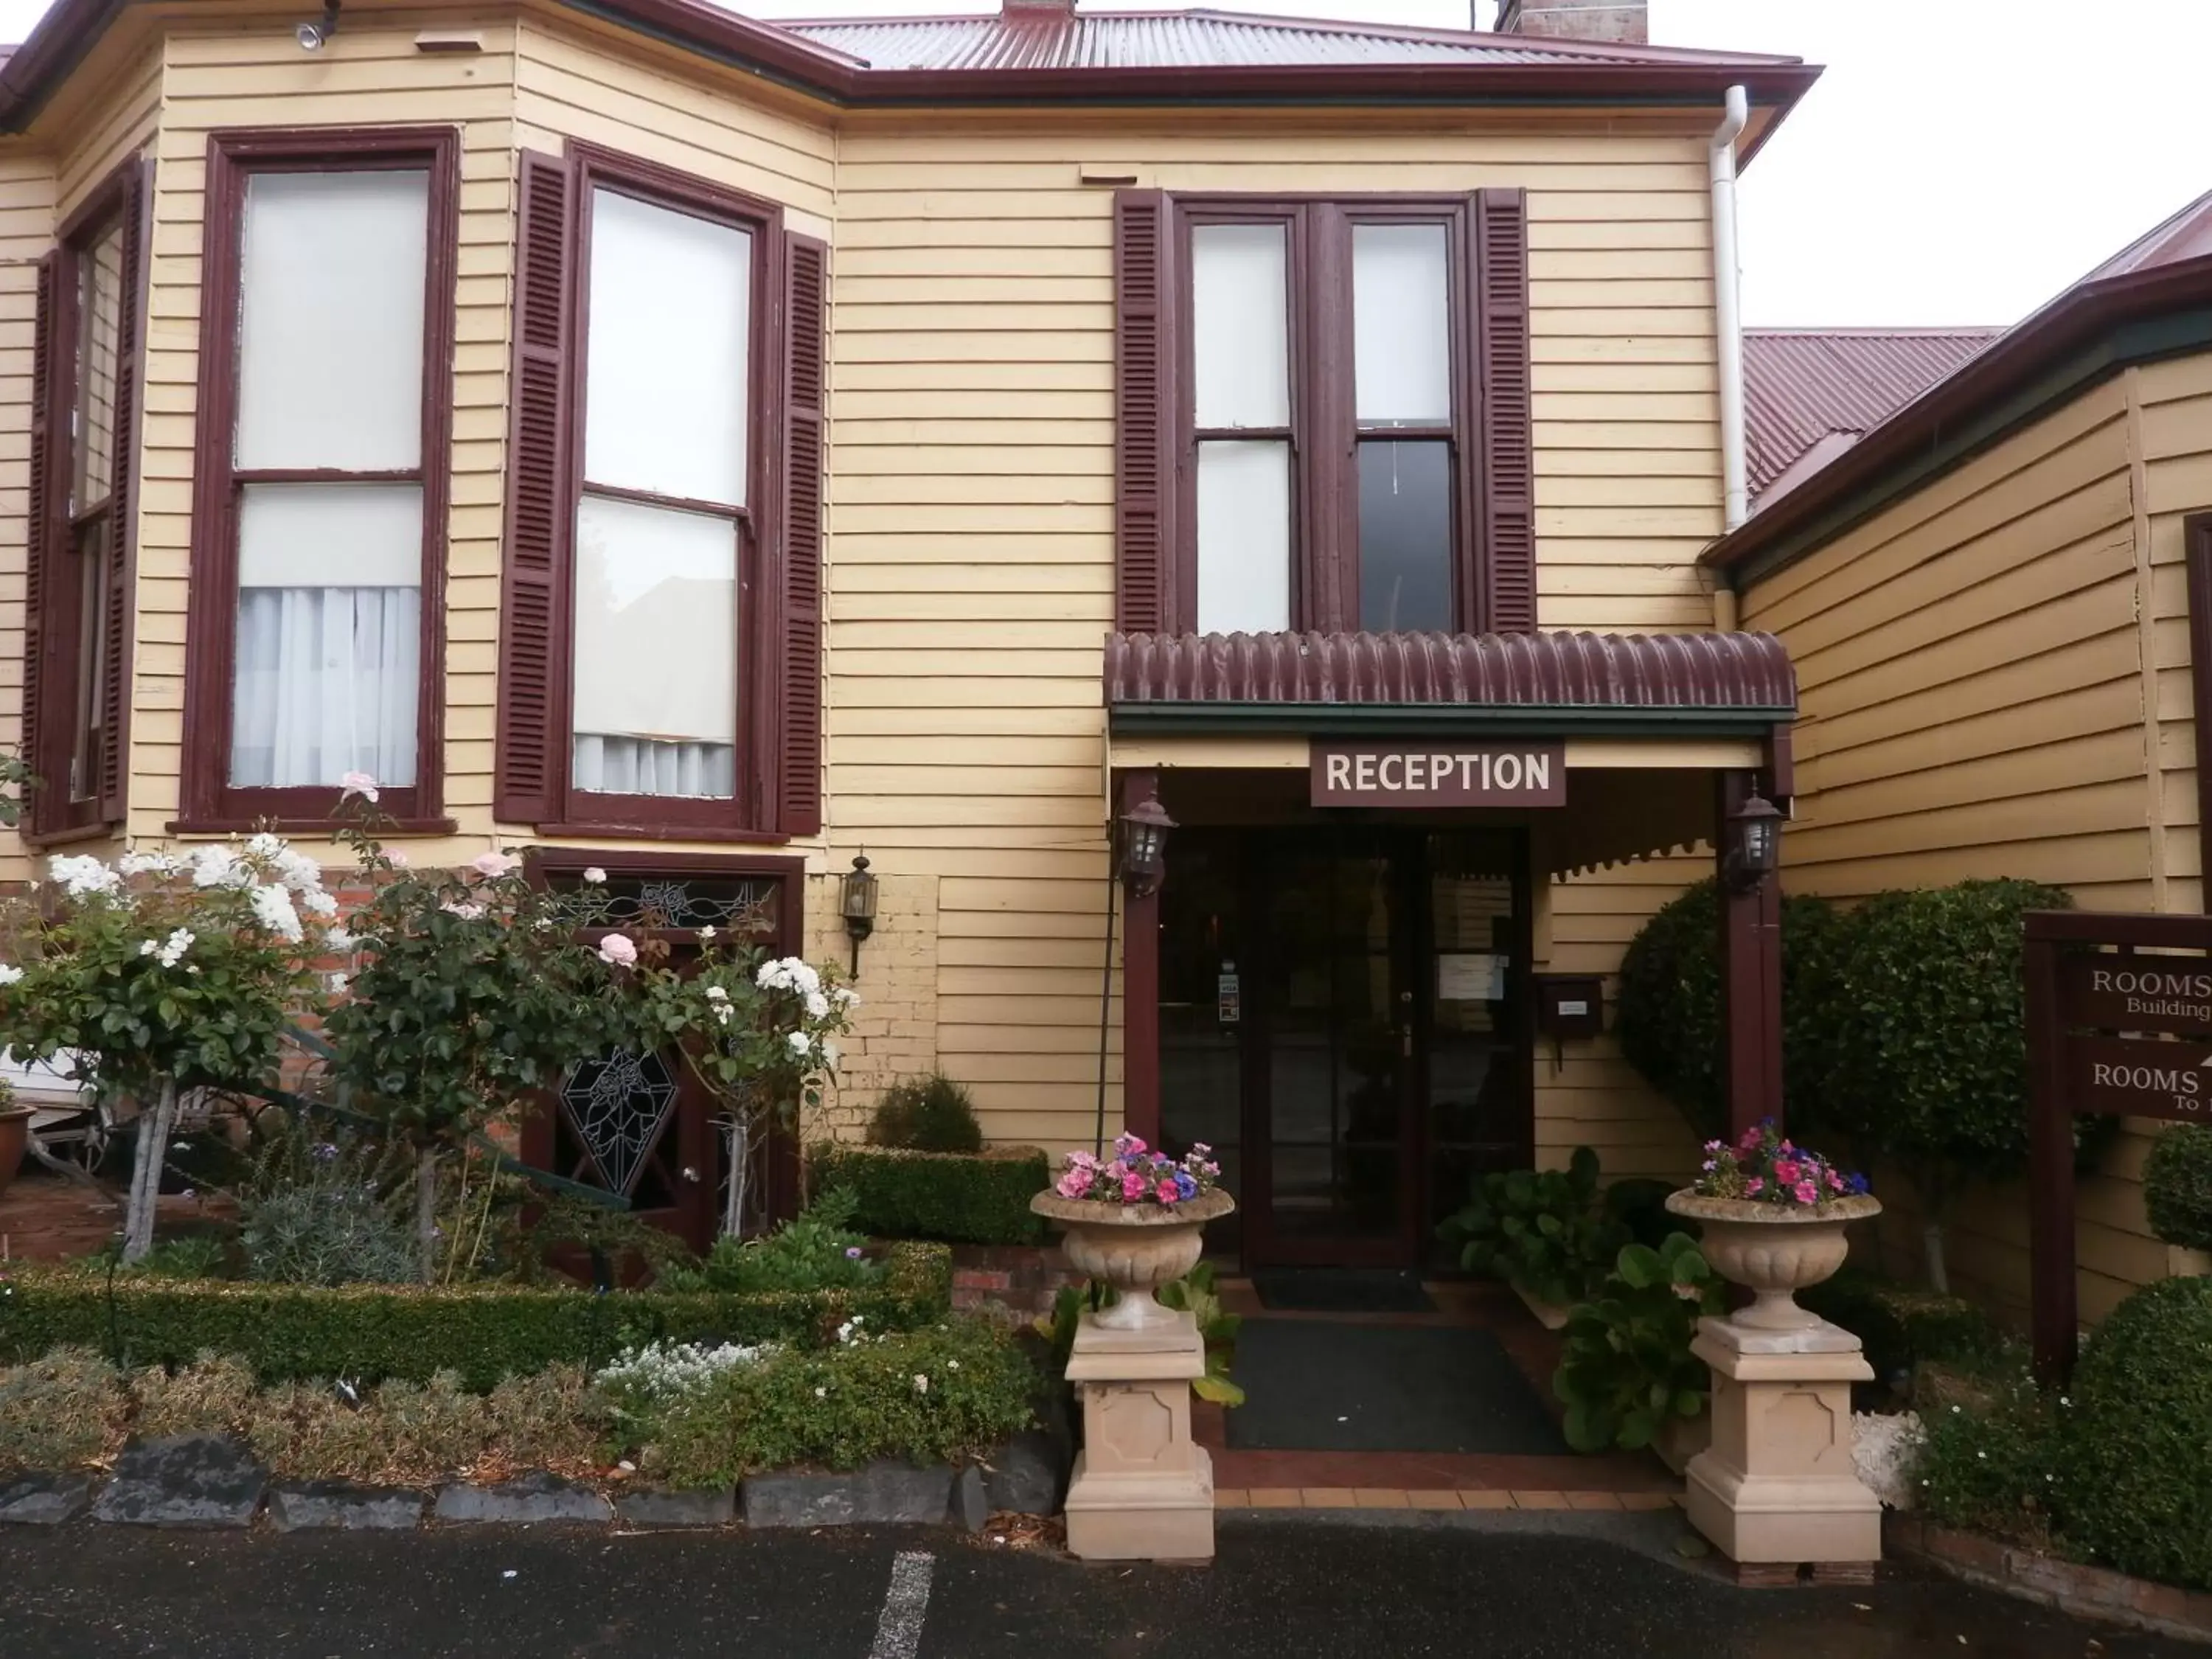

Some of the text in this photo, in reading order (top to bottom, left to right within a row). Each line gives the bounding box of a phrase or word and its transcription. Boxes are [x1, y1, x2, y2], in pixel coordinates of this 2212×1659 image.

[1327, 754, 1548, 790] RECEPTION
[2093, 970, 2212, 998] ROOMS
[2127, 997, 2211, 1022] Building
[2093, 1063, 2199, 1094] ROOMS
[2174, 1095, 2199, 1111] To
